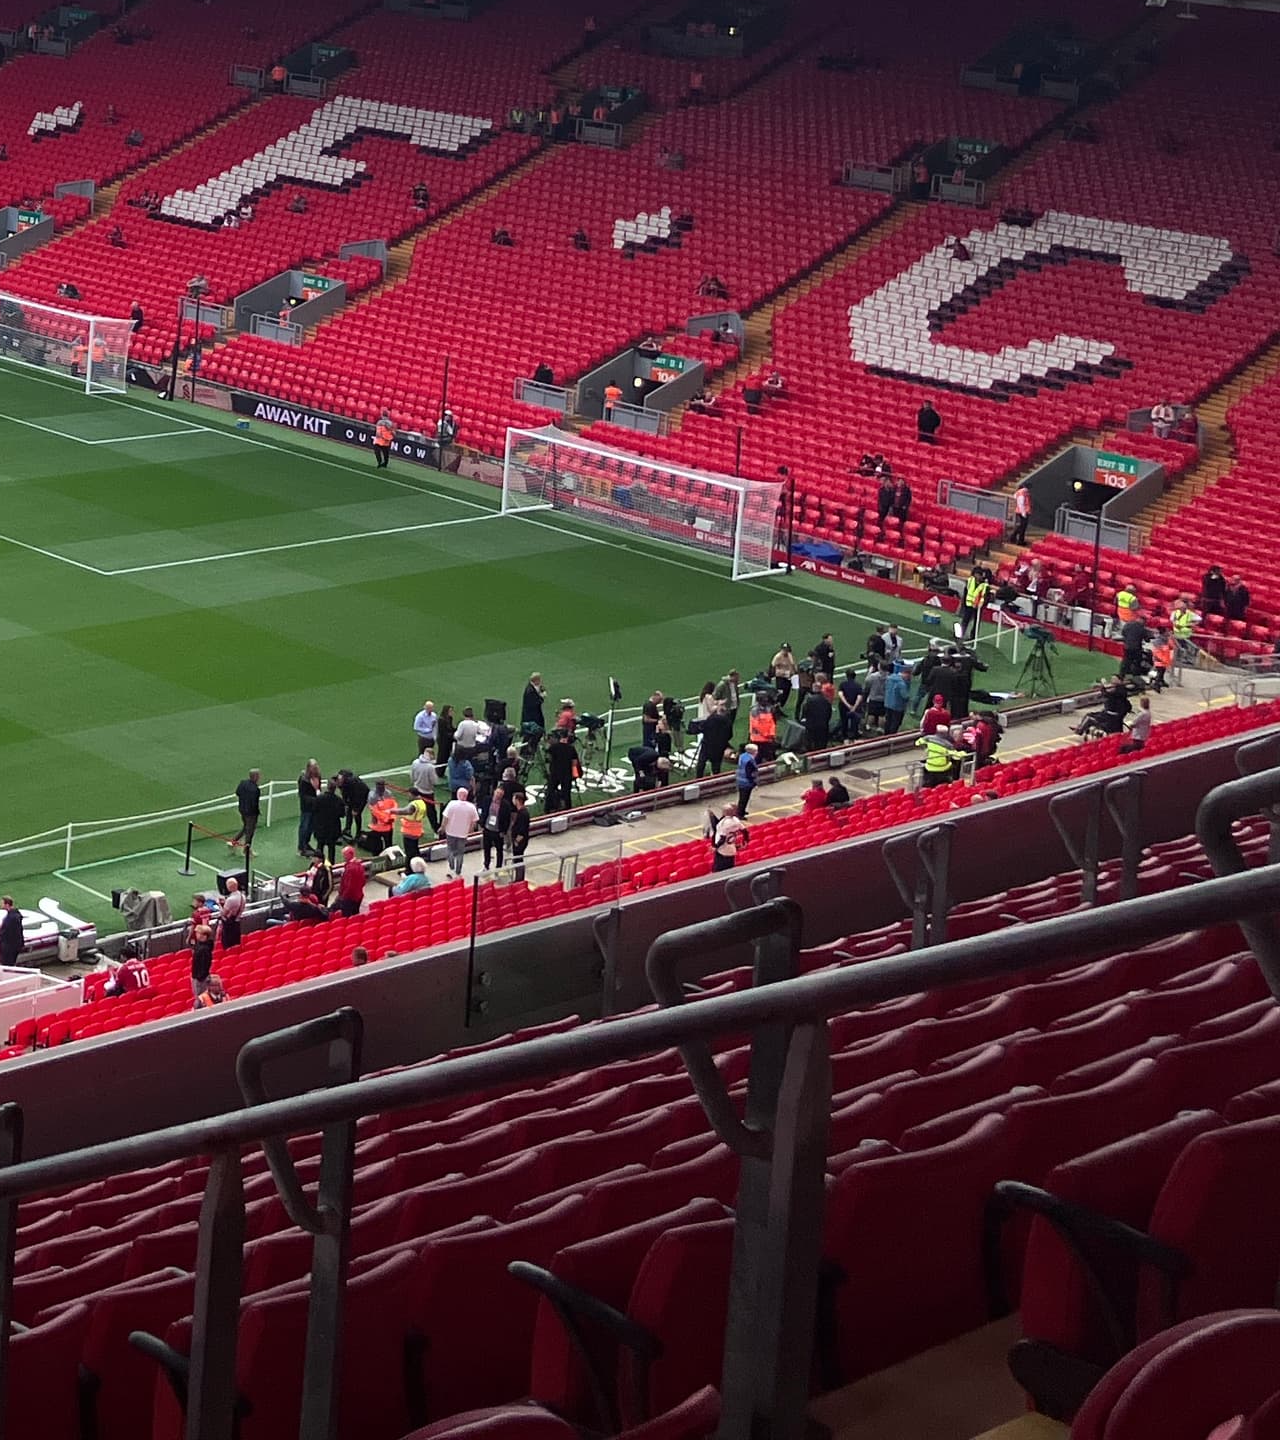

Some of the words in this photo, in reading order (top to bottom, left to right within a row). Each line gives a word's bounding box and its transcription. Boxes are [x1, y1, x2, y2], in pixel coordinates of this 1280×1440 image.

[255, 403, 303, 427] AWAY
[303, 413, 331, 436] KIT
[345, 429, 376, 445] OUT
[390, 442, 426, 459] NOW
[1097, 458, 1116, 469] EXIT
[1102, 473, 1127, 489] 103
[132, 969, 150, 988] 10
